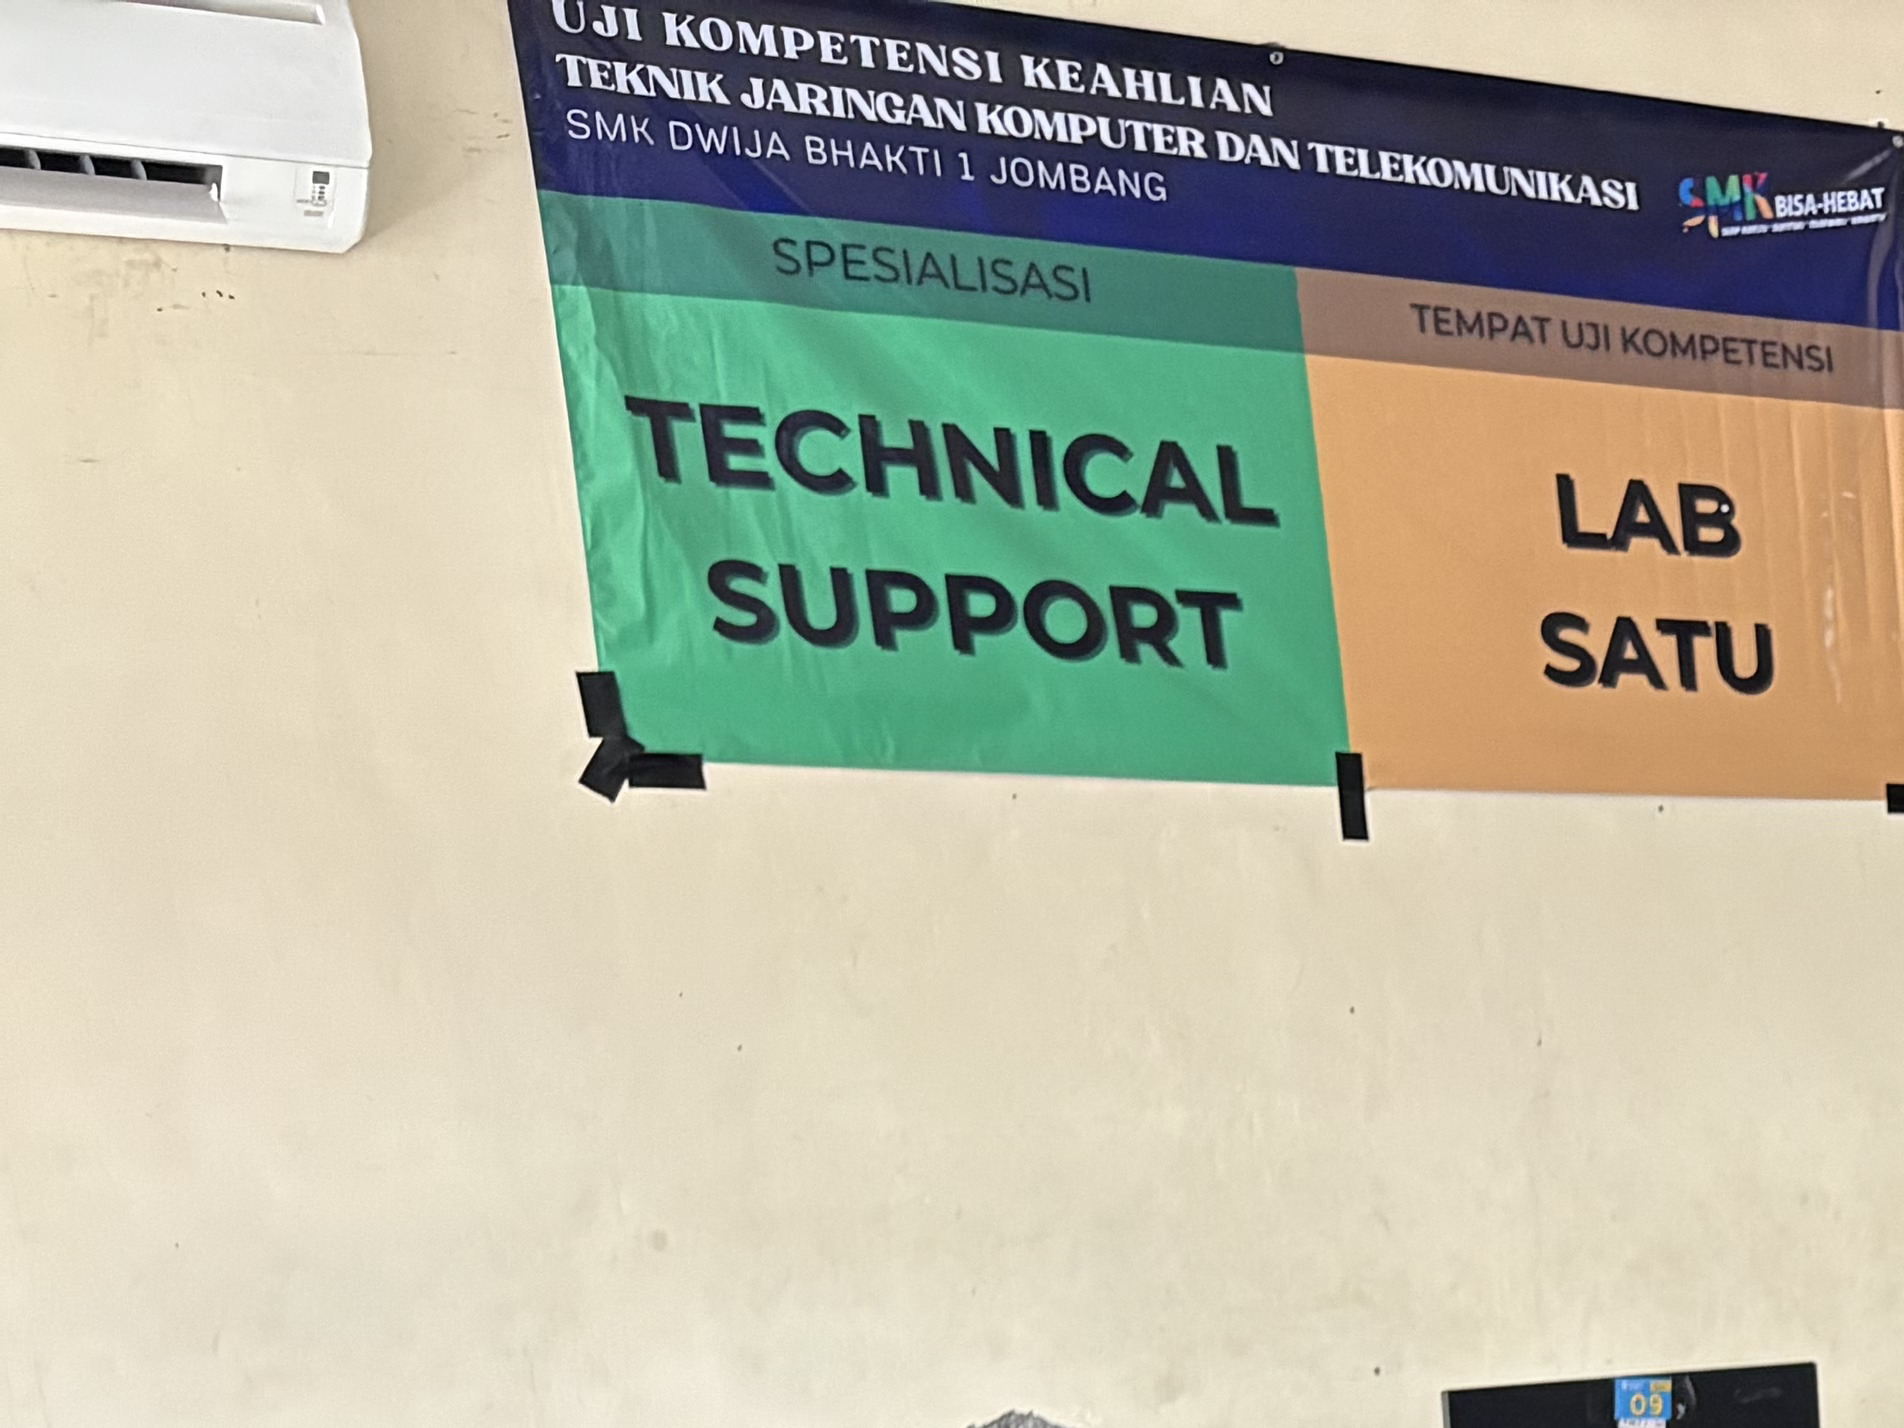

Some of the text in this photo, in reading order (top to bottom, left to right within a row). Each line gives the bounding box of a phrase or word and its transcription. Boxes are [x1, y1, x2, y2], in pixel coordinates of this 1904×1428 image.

[551, 0, 1275, 116] UJI KOMPETENSI KEAHLIAN
[554, 53, 1641, 211] TEKNIK JARINGAN KOMPUTER DAN TELEKOMUNIKASI
[566, 108, 1168, 202] SMK DWIJA BHAKTI 1 JOMBANG
[1679, 171, 1774, 238] SMK
[1775, 187, 1885, 218] BISA-HEBAT
[770, 238, 1094, 305] SPESIALISASI
[1411, 304, 1836, 375] TEMPAT UJI KOMPETENSI
[625, 395, 1279, 527] TECHNICAL
[1555, 471, 1742, 557] LAB
[703, 559, 1244, 670] SUPPORT
[1537, 609, 1775, 694] SATU
